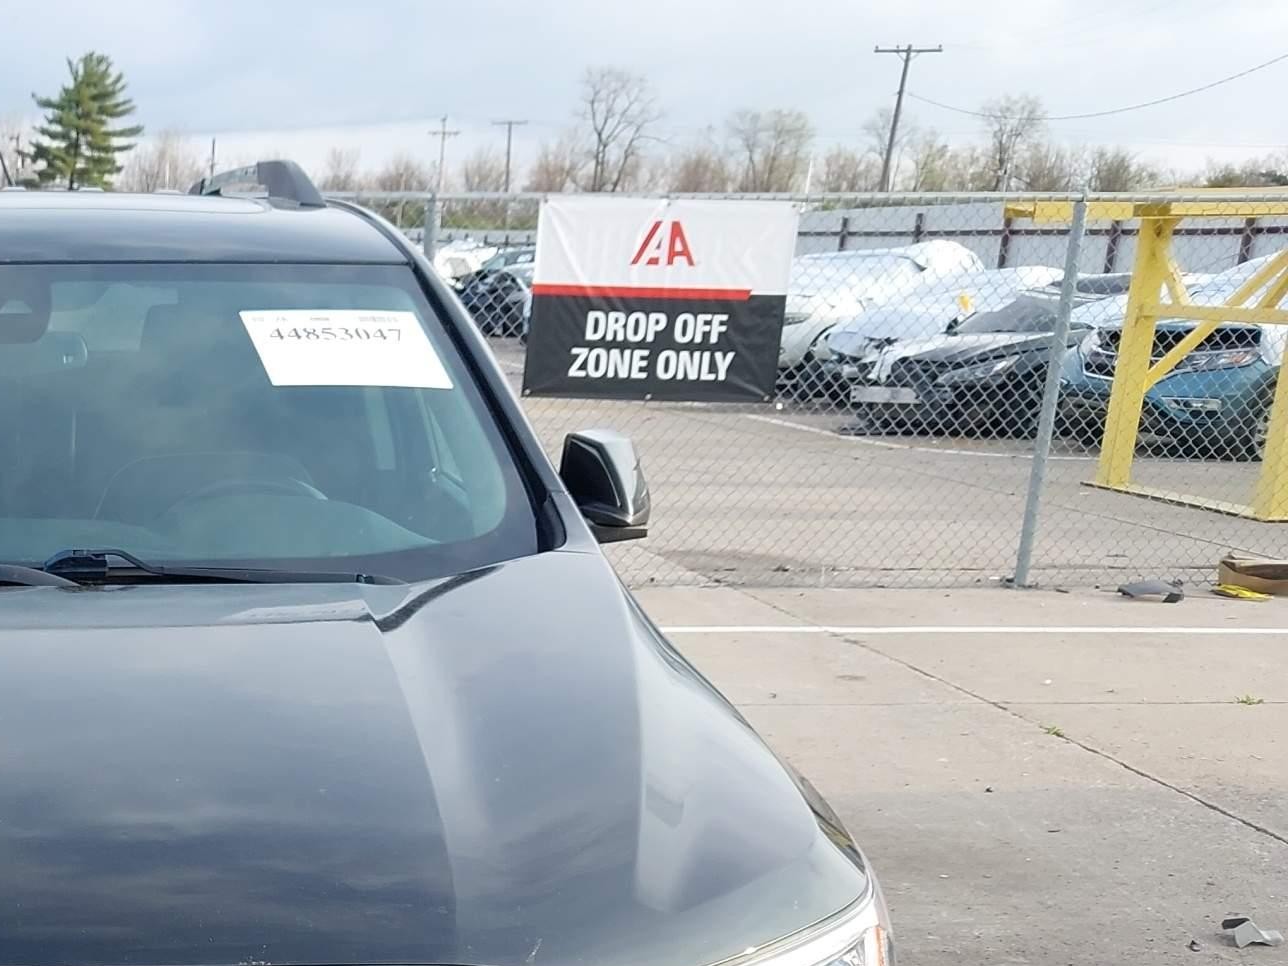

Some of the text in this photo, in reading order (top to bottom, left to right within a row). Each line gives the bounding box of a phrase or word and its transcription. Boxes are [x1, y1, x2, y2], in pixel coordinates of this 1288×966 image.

[269, 326, 401, 342] 44853047
[584, 310, 729, 344] DROP OFF
[567, 347, 736, 381] ZONE ONLY
